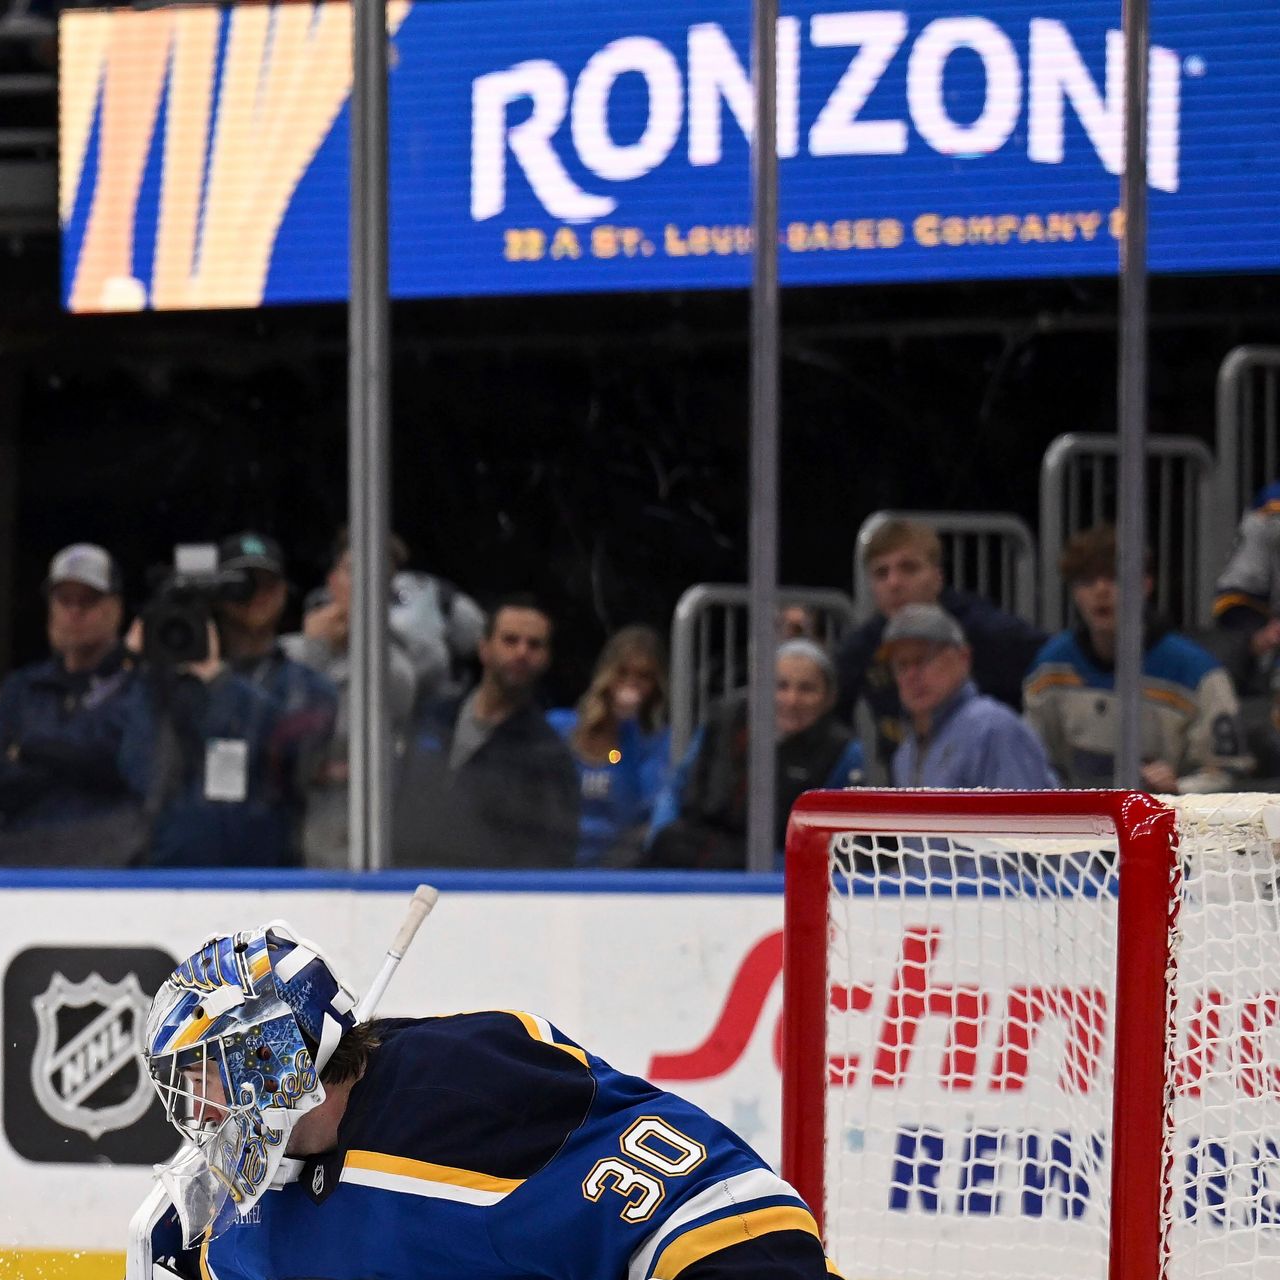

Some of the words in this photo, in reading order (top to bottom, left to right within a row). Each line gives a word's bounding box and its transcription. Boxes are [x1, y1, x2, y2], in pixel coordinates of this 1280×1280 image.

[470, 10, 1181, 224] RONZONI
[61, 1020, 134, 1096] NHL
[581, 1115, 708, 1224] 30
